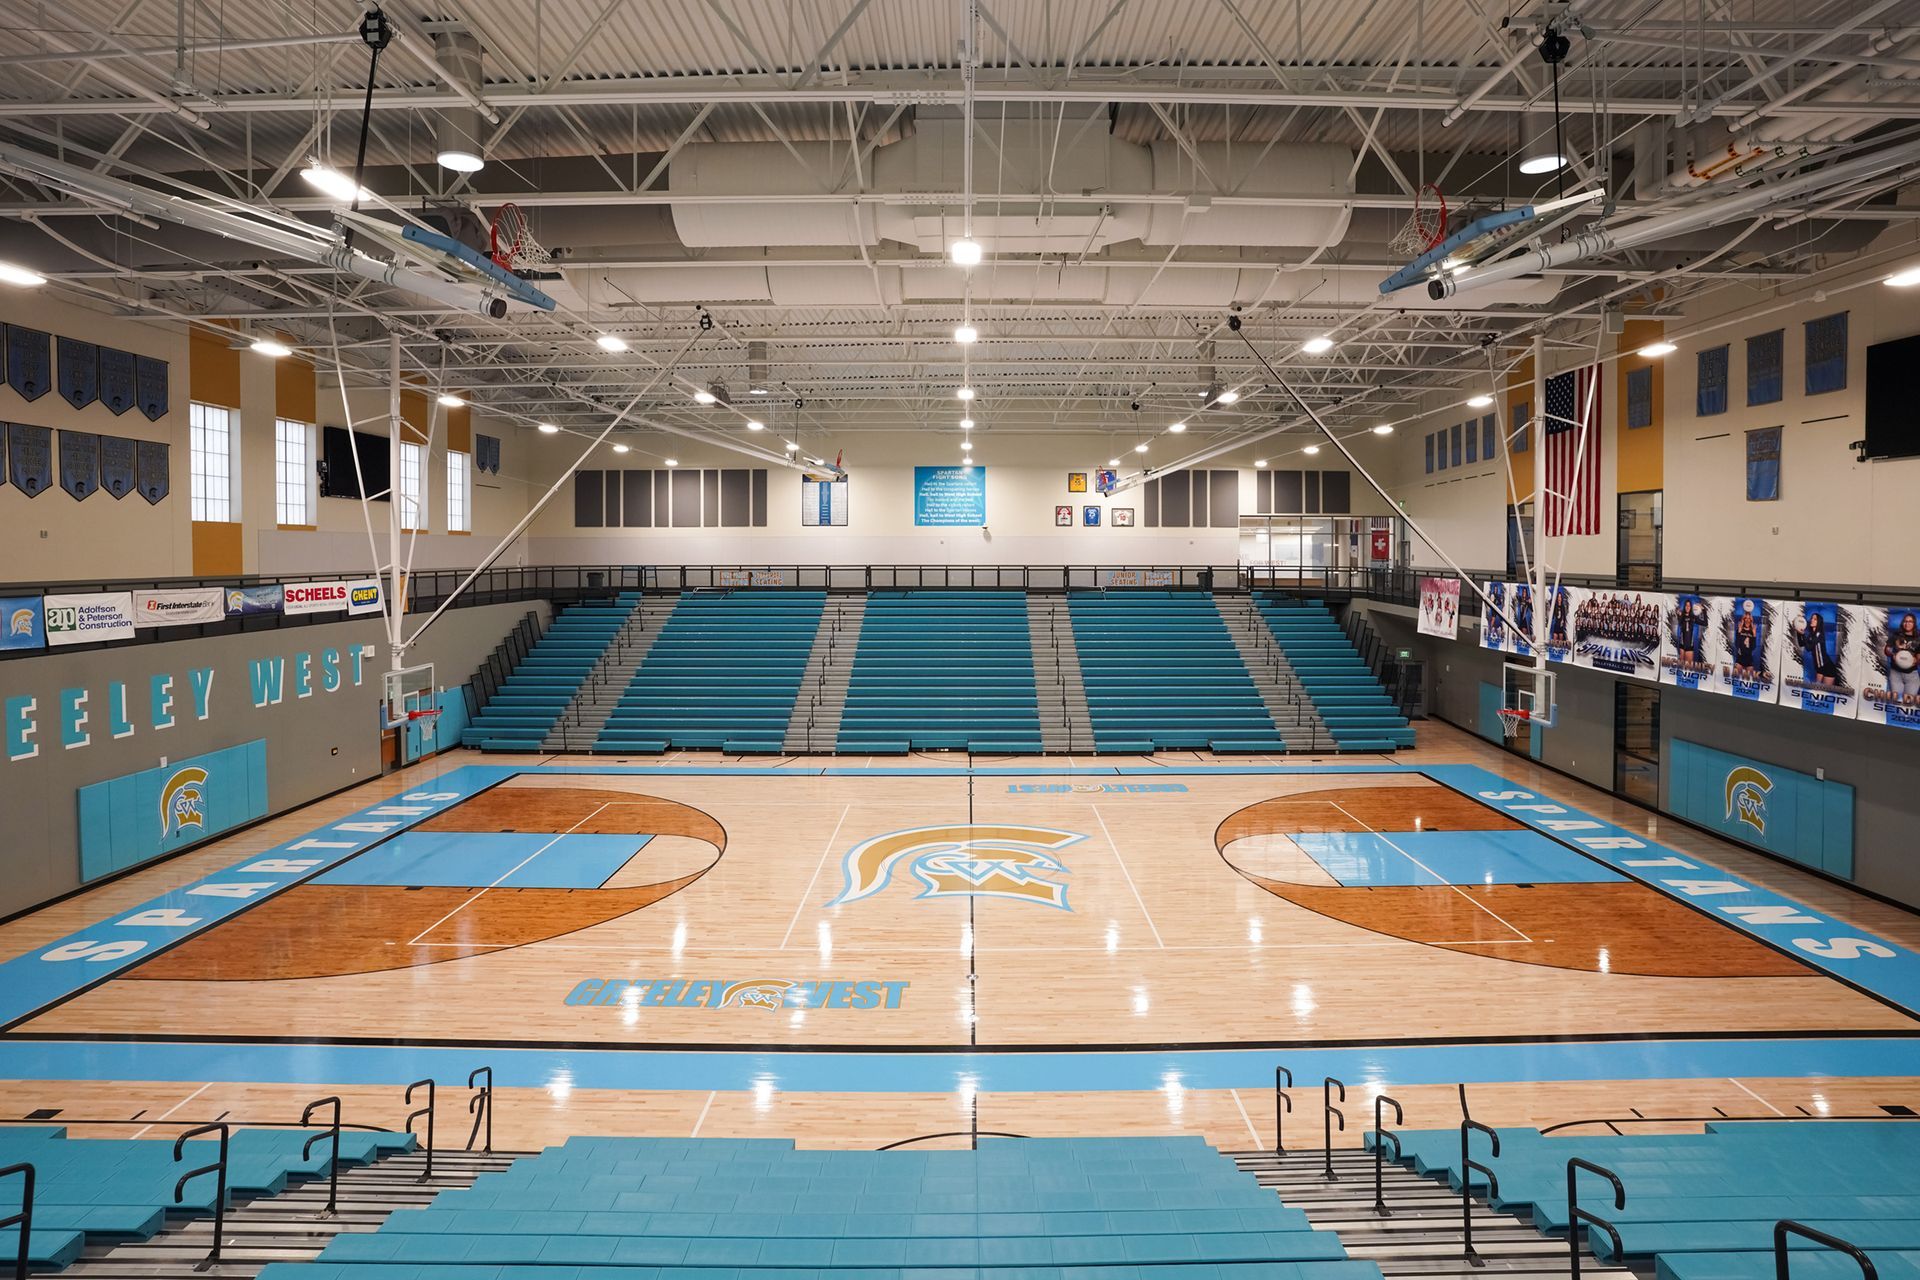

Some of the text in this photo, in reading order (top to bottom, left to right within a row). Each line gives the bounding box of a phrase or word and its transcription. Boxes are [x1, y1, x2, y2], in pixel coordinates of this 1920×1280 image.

[285, 586, 347, 603] SCHEELS
[352, 588, 378, 602] GHENT
[78, 605, 116, 614] Adolfson
[156, 603, 173, 611] First
[172, 601, 203, 610] Interstate
[48, 608, 76, 631] ap
[78, 620, 133, 630] Construction
[87, 613, 123, 621] Peterson
[1577, 642, 1656, 666] SPARTANS
[248, 644, 365, 708] WEST
[1668, 668, 1708, 681] SENIOR
[1724, 678, 1771, 692] SENIOR
[1791, 689, 1848, 705] SENIOR
[40, 791, 460, 962] SPARTANS
[1478, 790, 1897, 960] SPARTANS
[563, 977, 738, 1009] GREELEY
